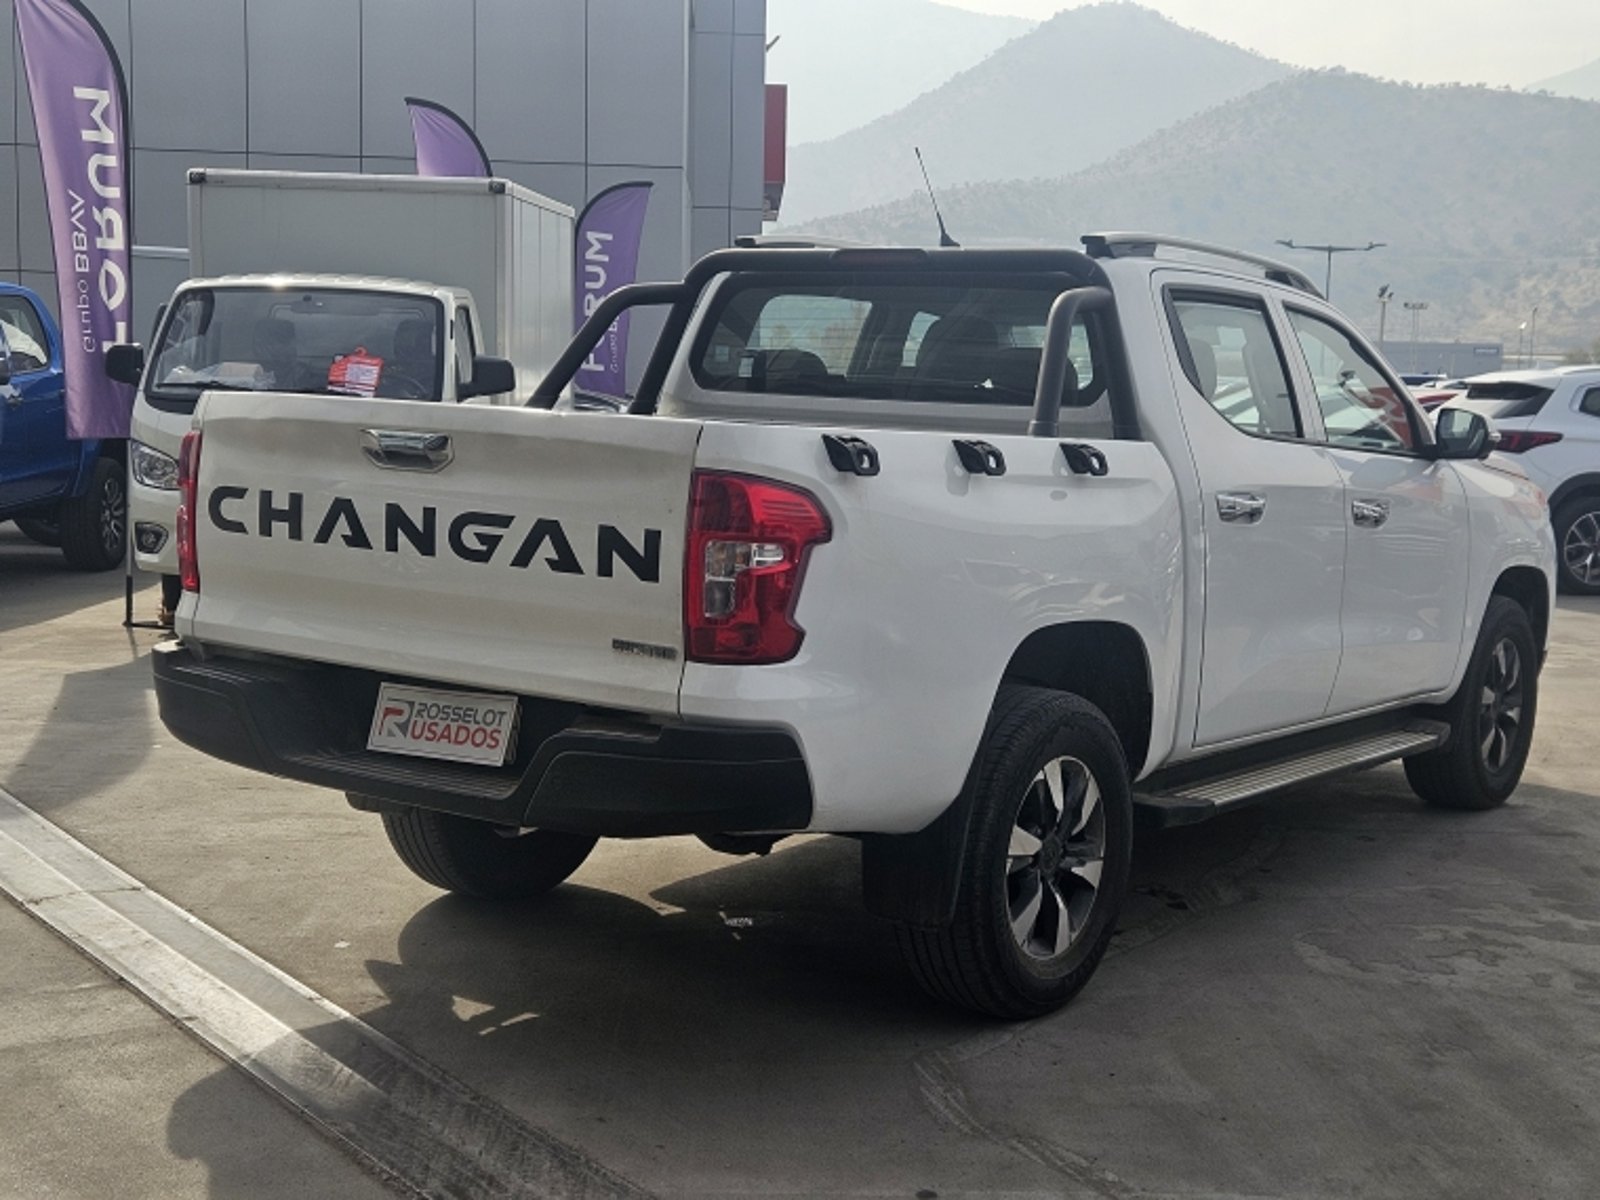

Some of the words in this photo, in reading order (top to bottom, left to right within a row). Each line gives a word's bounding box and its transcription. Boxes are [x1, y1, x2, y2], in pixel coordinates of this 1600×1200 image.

[580, 230, 614, 372] FRUM
[207, 485, 662, 583] CHANGAN
[410, 720, 502, 750] USADOS
[414, 702, 508, 727] ROSSELOT
